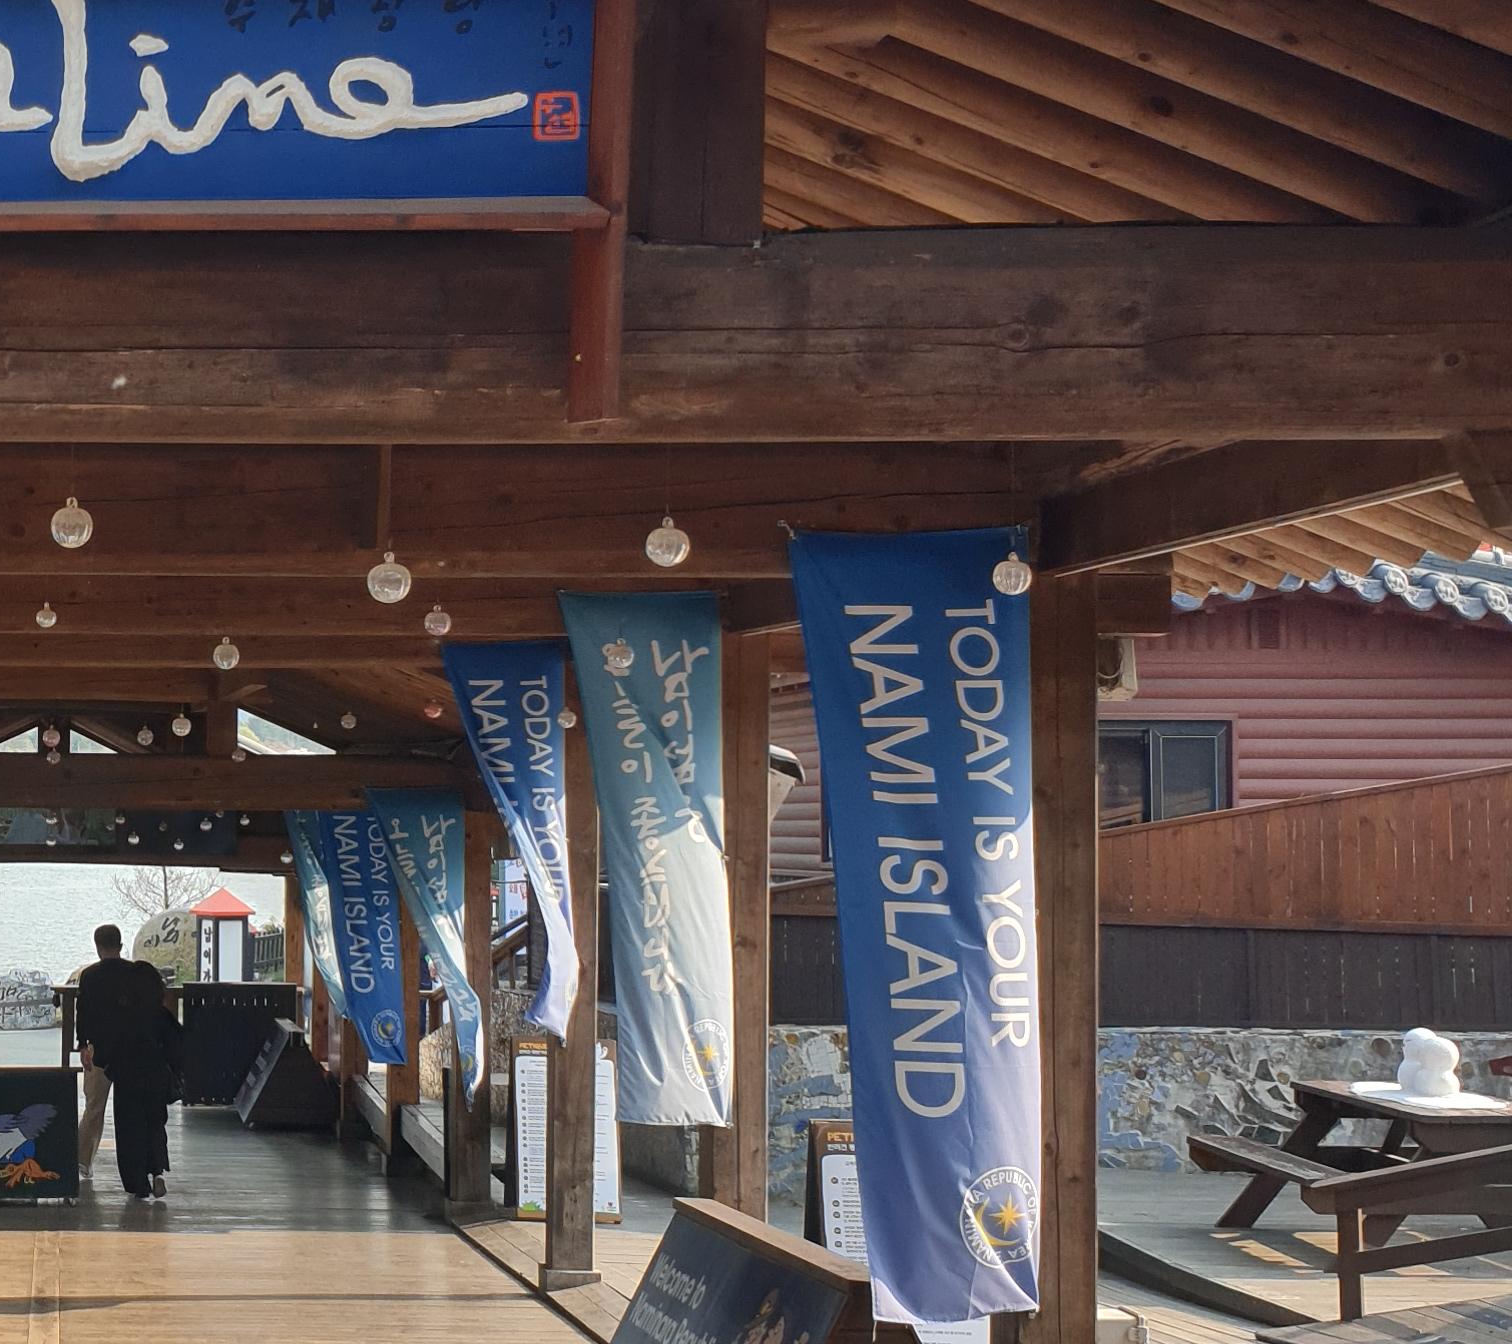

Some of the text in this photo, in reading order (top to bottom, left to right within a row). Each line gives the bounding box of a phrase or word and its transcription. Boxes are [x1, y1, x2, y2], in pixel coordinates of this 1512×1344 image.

[520, 676, 555, 777] TODAY
[532, 787, 557, 812] IS
[945, 599, 1031, 1048] TODAY IS YOUR
[844, 605, 966, 1118] NAMI ISLAND
[333, 815, 376, 994] NAMI ISLAND
[372, 889, 390, 906] IS
[376, 910, 395, 971] YOUR
[982, 1170, 1032, 1196] REPUBLIC
[649, 1252, 707, 1310] Welcome to
